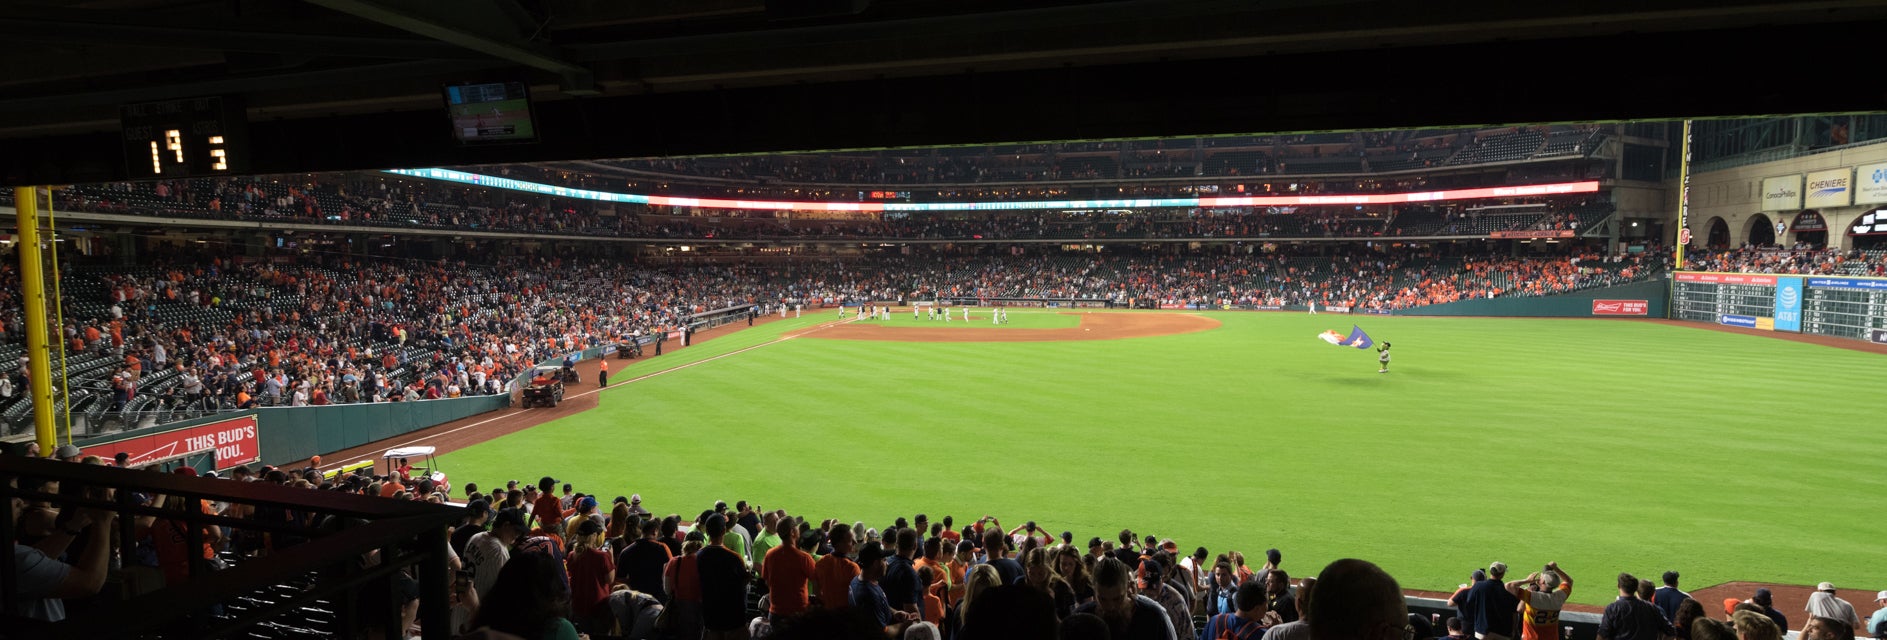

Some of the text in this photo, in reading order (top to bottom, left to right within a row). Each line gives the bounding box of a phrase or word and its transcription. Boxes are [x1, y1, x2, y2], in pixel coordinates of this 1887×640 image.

[1810, 178, 1848, 190] CHENIERE
[1777, 311, 1798, 322] AT&T
[185, 425, 255, 451] THIS BUD'S
[215, 444, 244, 461] YOU.
